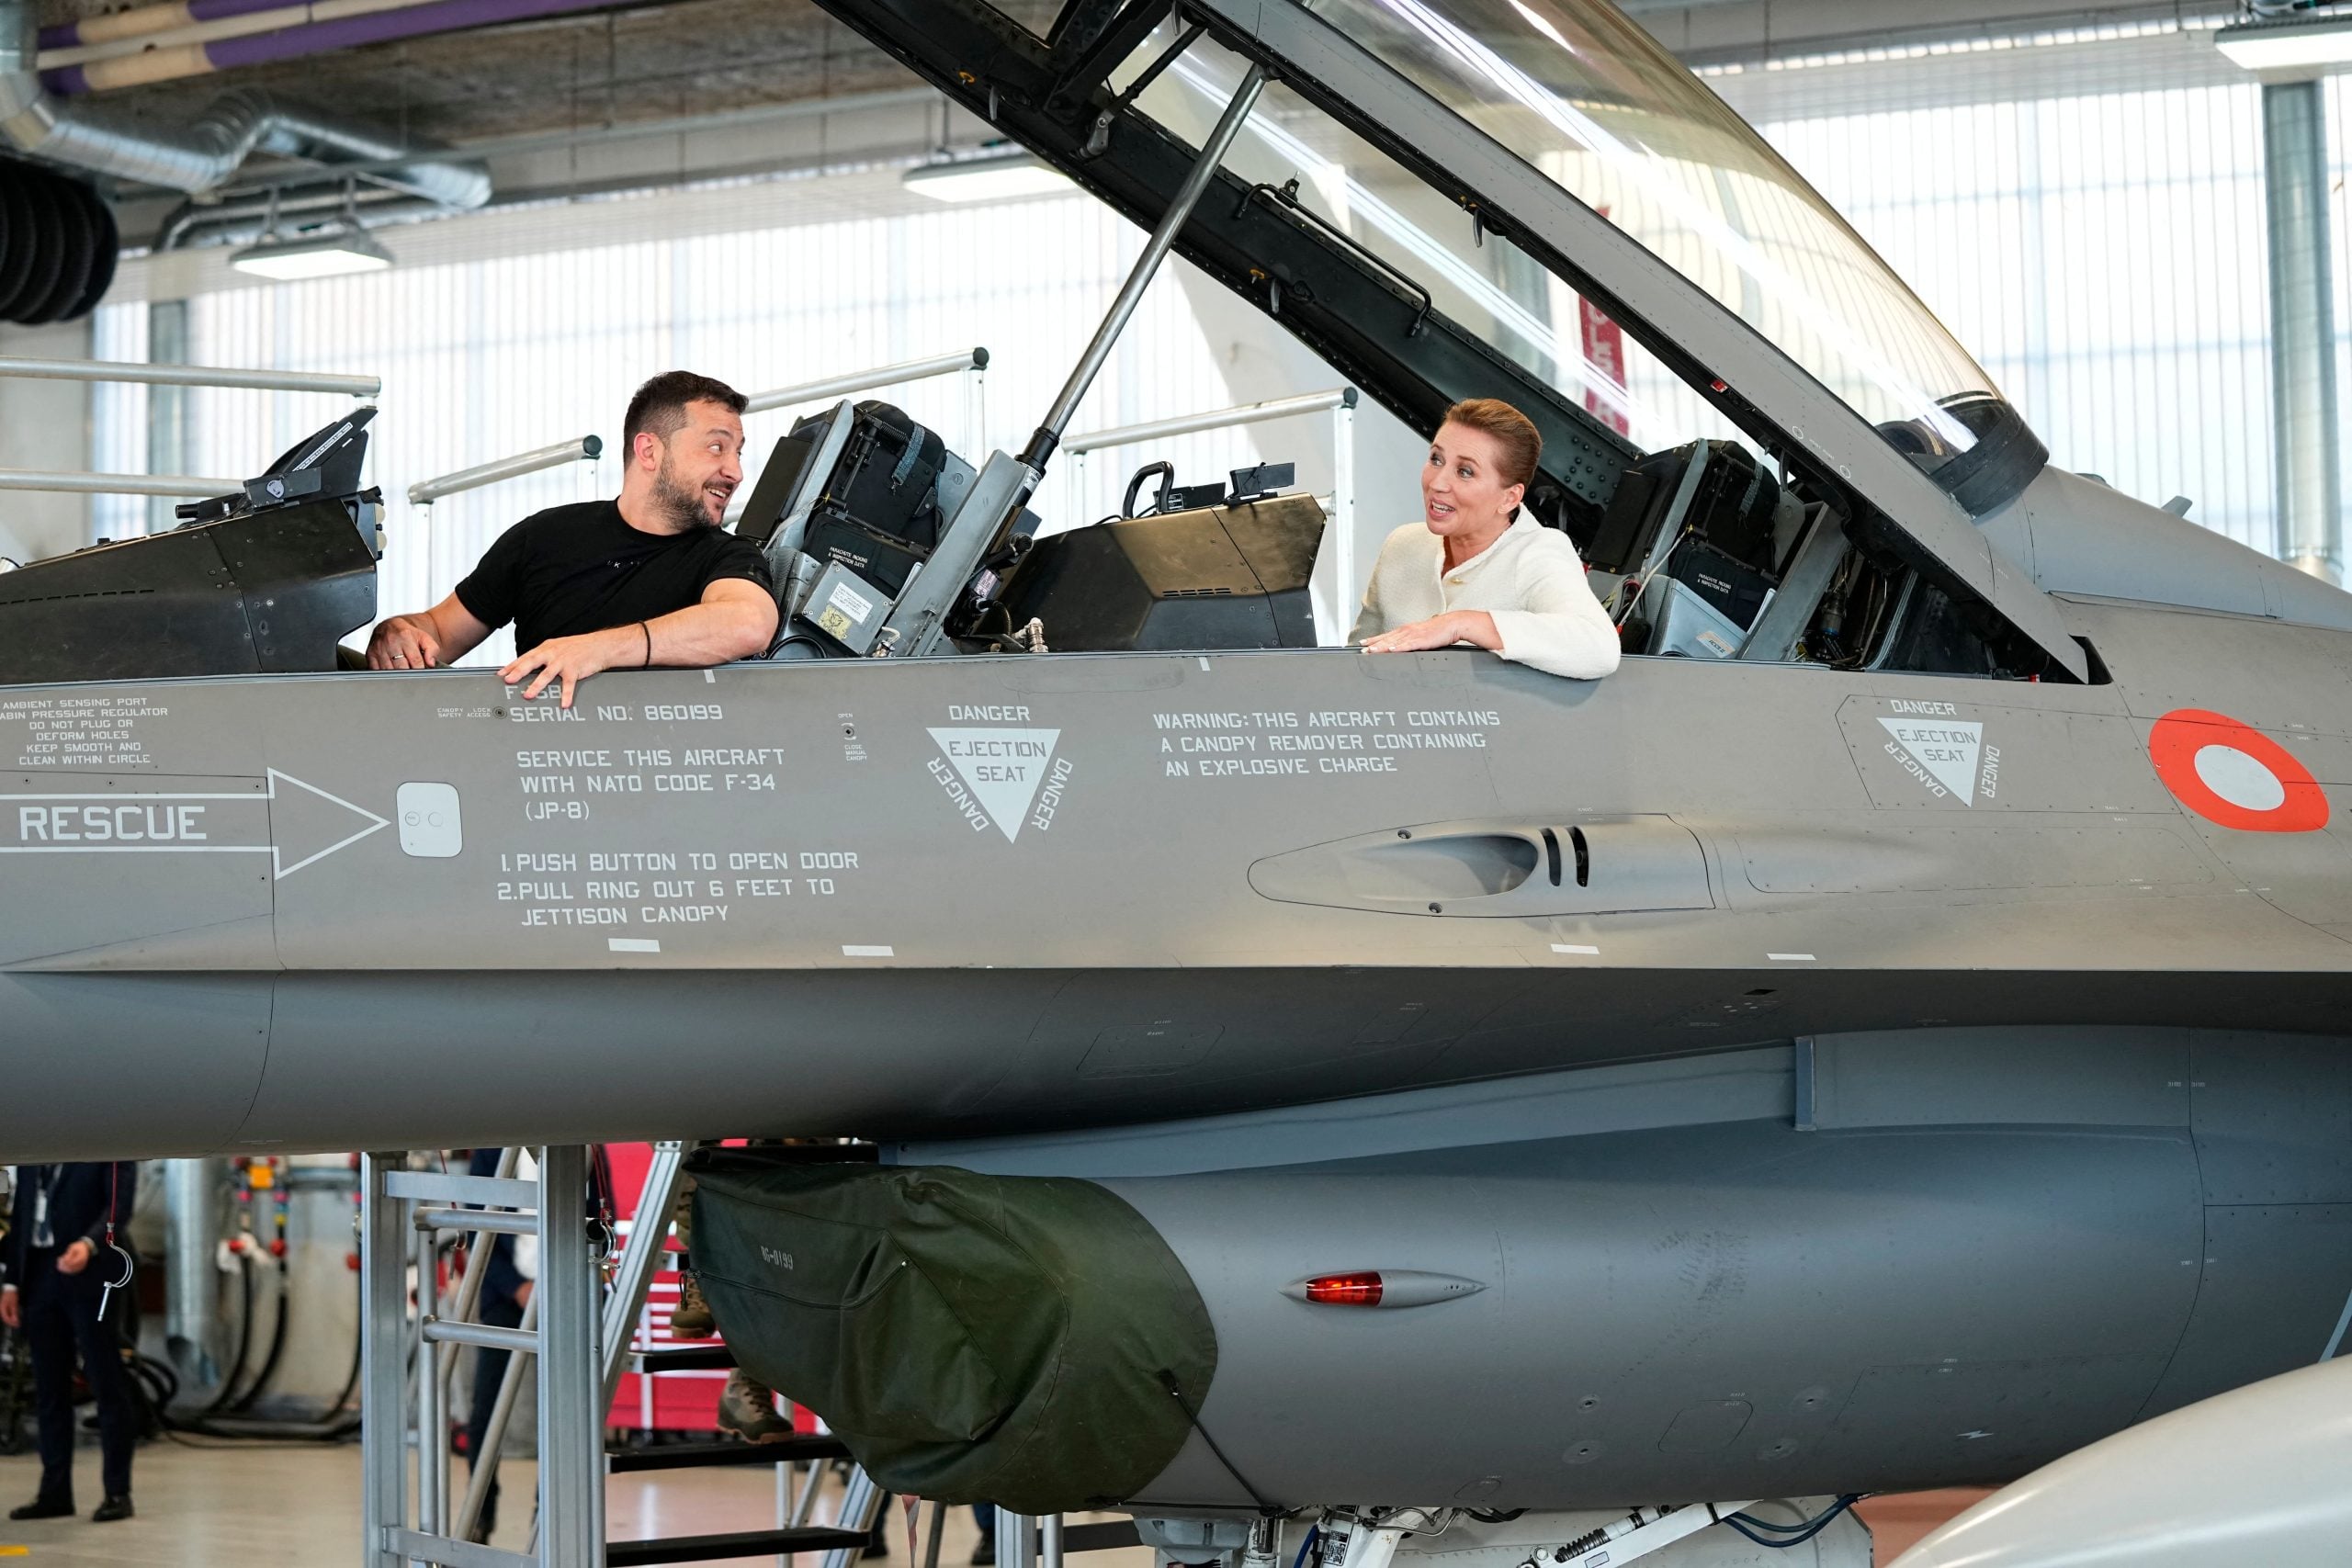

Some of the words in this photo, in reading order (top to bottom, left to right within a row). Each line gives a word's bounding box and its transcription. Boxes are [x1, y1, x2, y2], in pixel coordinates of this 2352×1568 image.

[3, 701, 52, 709] AMBIENT
[60, 699, 110, 707] SENSING
[32, 709, 95, 718] PRESSURE
[101, 708, 167, 716] REGULATOR
[510, 705, 585, 722] SERIAL
[645, 705, 723, 721] 860199
[948, 705, 1030, 722] DANGER
[1890, 699, 1956, 716] DANGER
[29, 722, 44, 730] DO
[51, 721, 74, 729] NOT
[118, 719, 133, 728] OR
[1153, 714, 1250, 729] WARNING:
[1252, 713, 1298, 728] THIS
[1309, 712, 1396, 728] AIRCRAFT
[1408, 710, 1500, 727] CONTAINS
[37, 732, 85, 740] DEFORM
[92, 731, 129, 739] HOLES
[1160, 737, 1172, 753] A
[1180, 736, 1258, 752] CANOPY
[1268, 734, 1363, 750] REMOVER
[1373, 733, 1487, 750] CONTAINING
[1897, 728, 1977, 745] EJECTION
[27, 744, 57, 752] KEEP
[64, 743, 112, 752] SMOOTH
[119, 742, 141, 750] AND
[950, 739, 1046, 759] EJECTION
[1924, 747, 1966, 762] SEAT
[19, 756, 55, 764] CLEAN
[62, 755, 102, 764] WITHIN
[108, 755, 151, 763] CIRCLE
[516, 750, 612, 768] SERVICE
[624, 750, 673, 767] THIS
[684, 749, 785, 766] AIRCRAFT
[1165, 760, 1190, 777] AN
[1201, 758, 1309, 776] EXPLOSIVE
[1319, 757, 1398, 773] CHARGE
[976, 765, 1026, 784] SEAT
[1883, 740, 1949, 800] DANGER
[1980, 744, 2001, 799] DANGER
[521, 775, 575, 793] WITH
[587, 775, 642, 792] NATO
[655, 774, 713, 791] CODE
[726, 773, 775, 790] F-34
[924, 756, 989, 833] DANGER
[1031, 757, 1073, 832] DANGER
[525, 801, 591, 820] (JP-8)
[19, 806, 208, 841] RESCUE
[517, 853, 577, 872] PUSH
[590, 852, 676, 871] BUTTON
[689, 852, 717, 871] TO
[729, 852, 787, 870] OPEN
[800, 852, 859, 870] DOOR
[587, 881, 640, 899] RING
[653, 880, 695, 898] OUT
[709, 880, 724, 897] 6
[737, 879, 793, 897] FEET
[806, 878, 835, 896] TO
[522, 907, 628, 926] JETTISON
[642, 906, 729, 923] CANOPY
